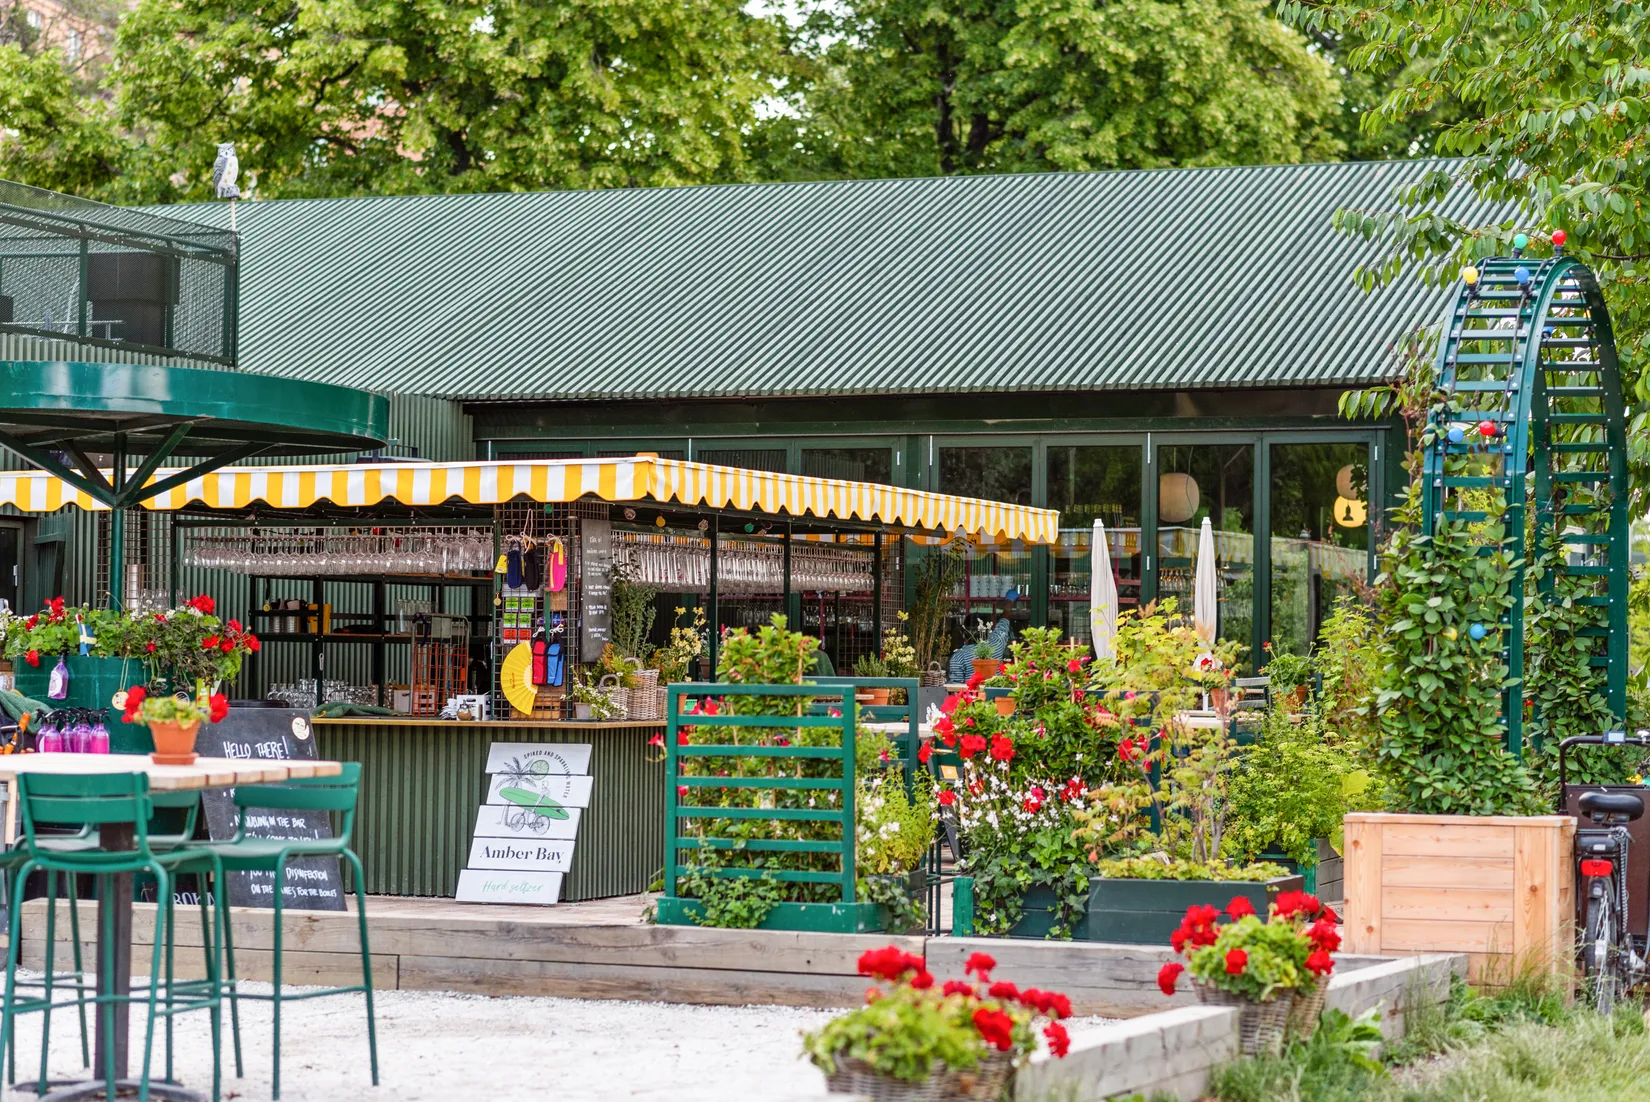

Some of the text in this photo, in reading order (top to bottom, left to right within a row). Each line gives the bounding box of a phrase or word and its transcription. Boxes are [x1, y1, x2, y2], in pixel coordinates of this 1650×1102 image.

[223, 735, 291, 760] HELLO THERE!
[524, 750, 543, 760] SPIKED
[554, 754, 571, 780] SPARKLING
[563, 781, 571, 799] WATER
[276, 816, 290, 828] THE
[292, 817, 307, 829] BAR
[480, 845, 565, 864] Amber Bay
[250, 883, 262, 895] ON
[260, 884, 274, 895] THE
[296, 886, 309, 897] FOR
[482, 880, 544, 895] Hard seltzer
